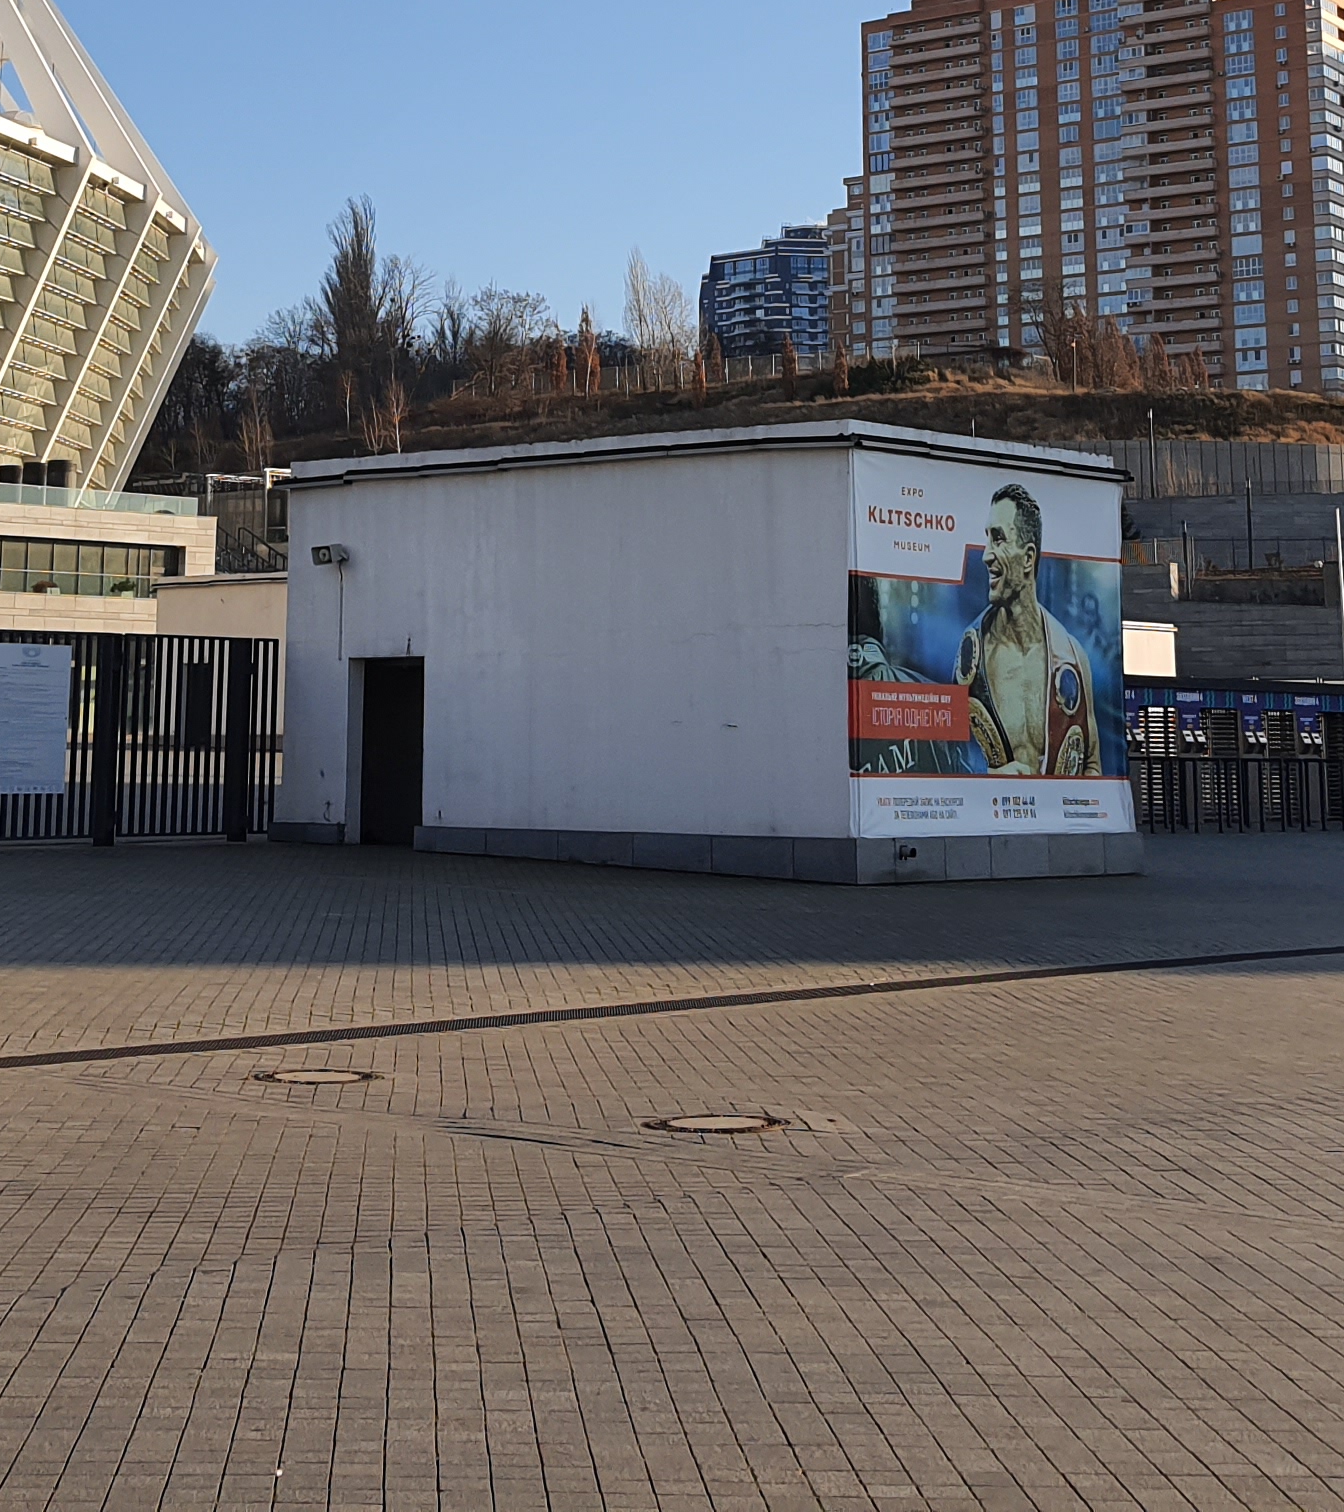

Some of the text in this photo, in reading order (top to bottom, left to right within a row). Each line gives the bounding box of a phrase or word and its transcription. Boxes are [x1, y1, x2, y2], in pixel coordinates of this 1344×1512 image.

[901, 486, 924, 498] EXPO
[868, 504, 956, 532] KLITSCHKO
[893, 540, 931, 553] MUSEUM
